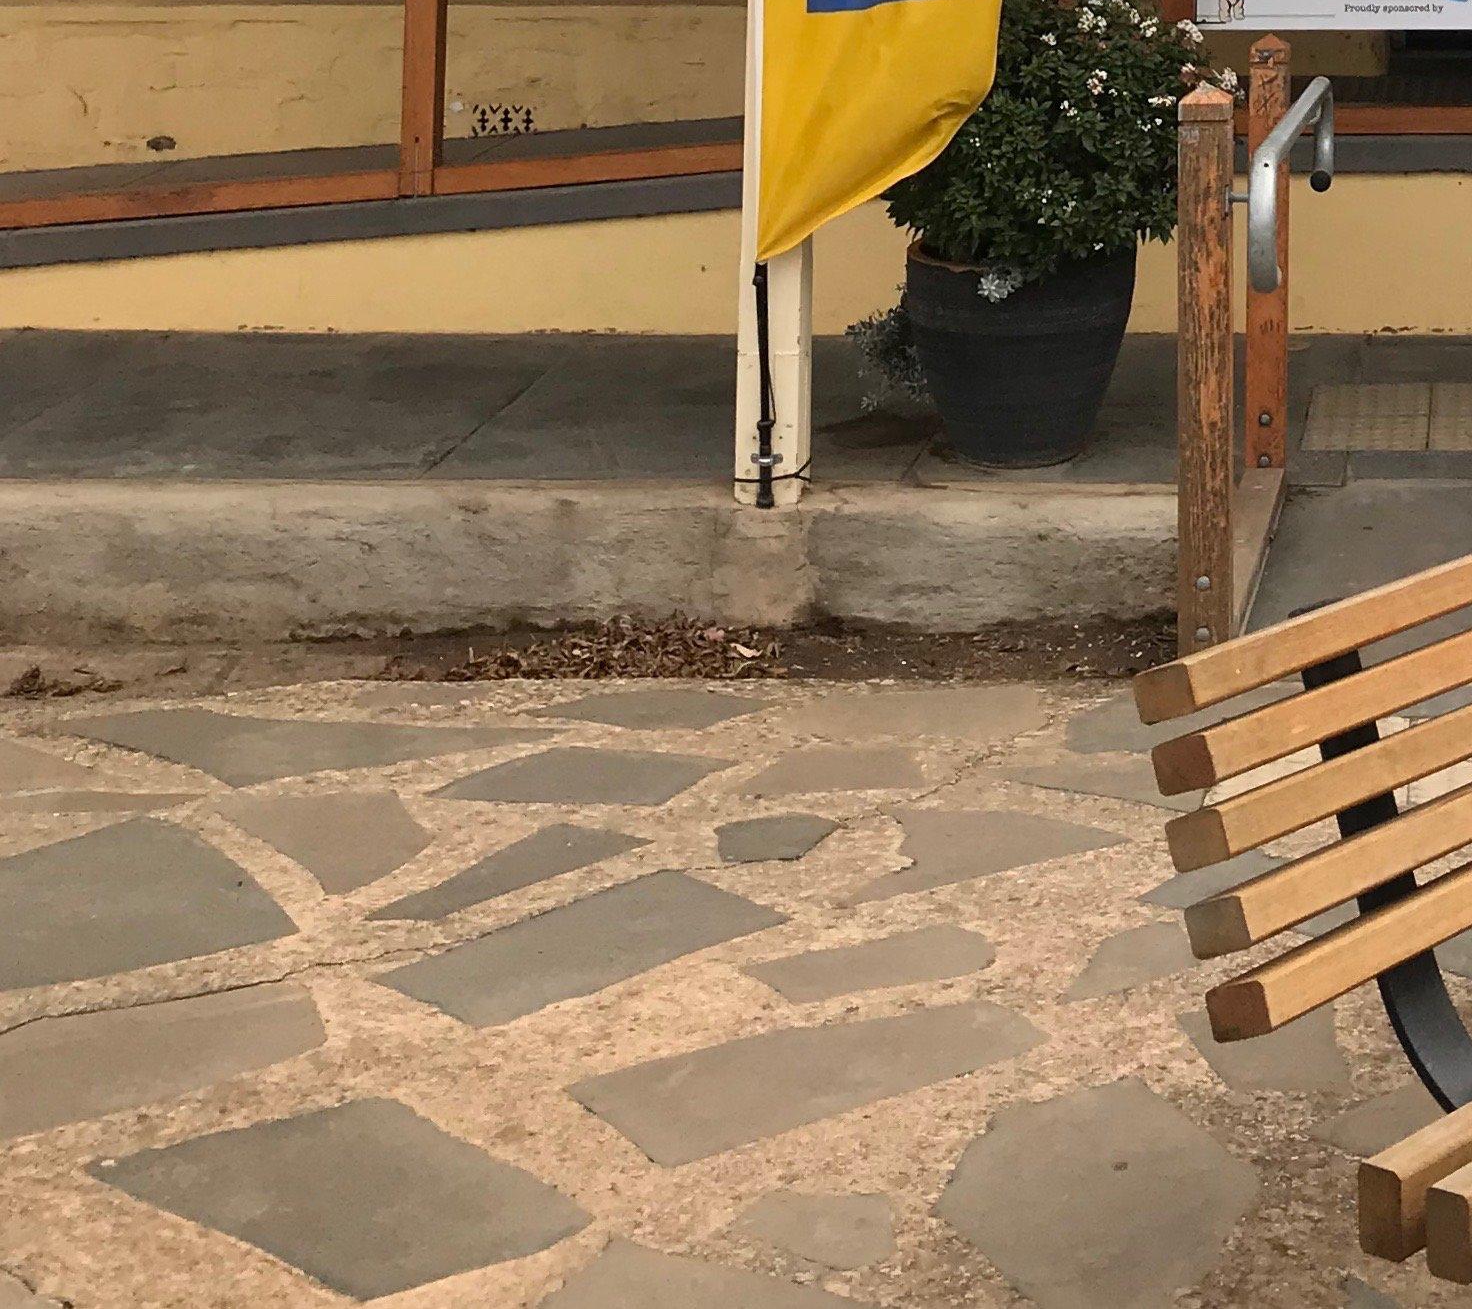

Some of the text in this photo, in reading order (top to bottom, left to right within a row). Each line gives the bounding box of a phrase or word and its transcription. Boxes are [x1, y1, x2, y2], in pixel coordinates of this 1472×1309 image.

[1344, 3, 1444, 14] Proudly sponsored by
